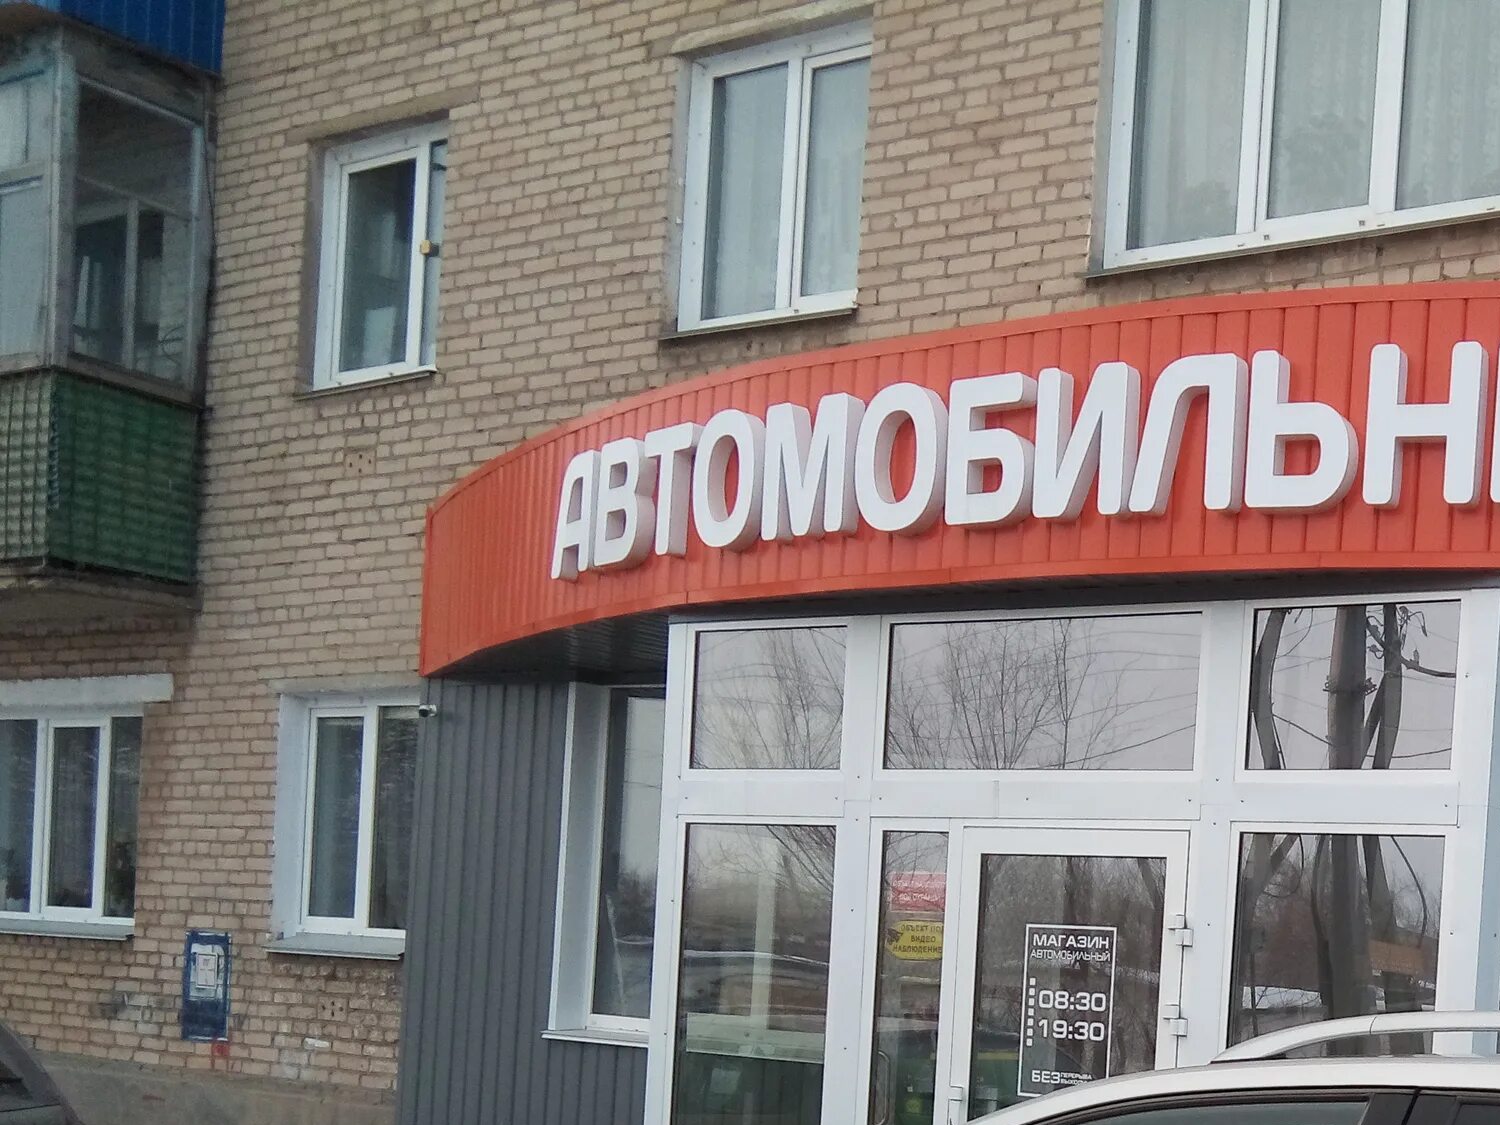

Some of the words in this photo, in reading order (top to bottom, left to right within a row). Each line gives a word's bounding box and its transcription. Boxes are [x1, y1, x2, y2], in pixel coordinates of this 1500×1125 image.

[911, 935, 936, 943] ВИДЕО
[1033, 934, 1109, 949] МАГАЗИН
[1030, 949, 1111, 962] АВТОМОБИЛЬНЫЙ
[1038, 990, 1107, 1012] 08:30
[1038, 1019, 1105, 1041] 19:30
[1031, 1069, 1060, 1084] БЕЗ
